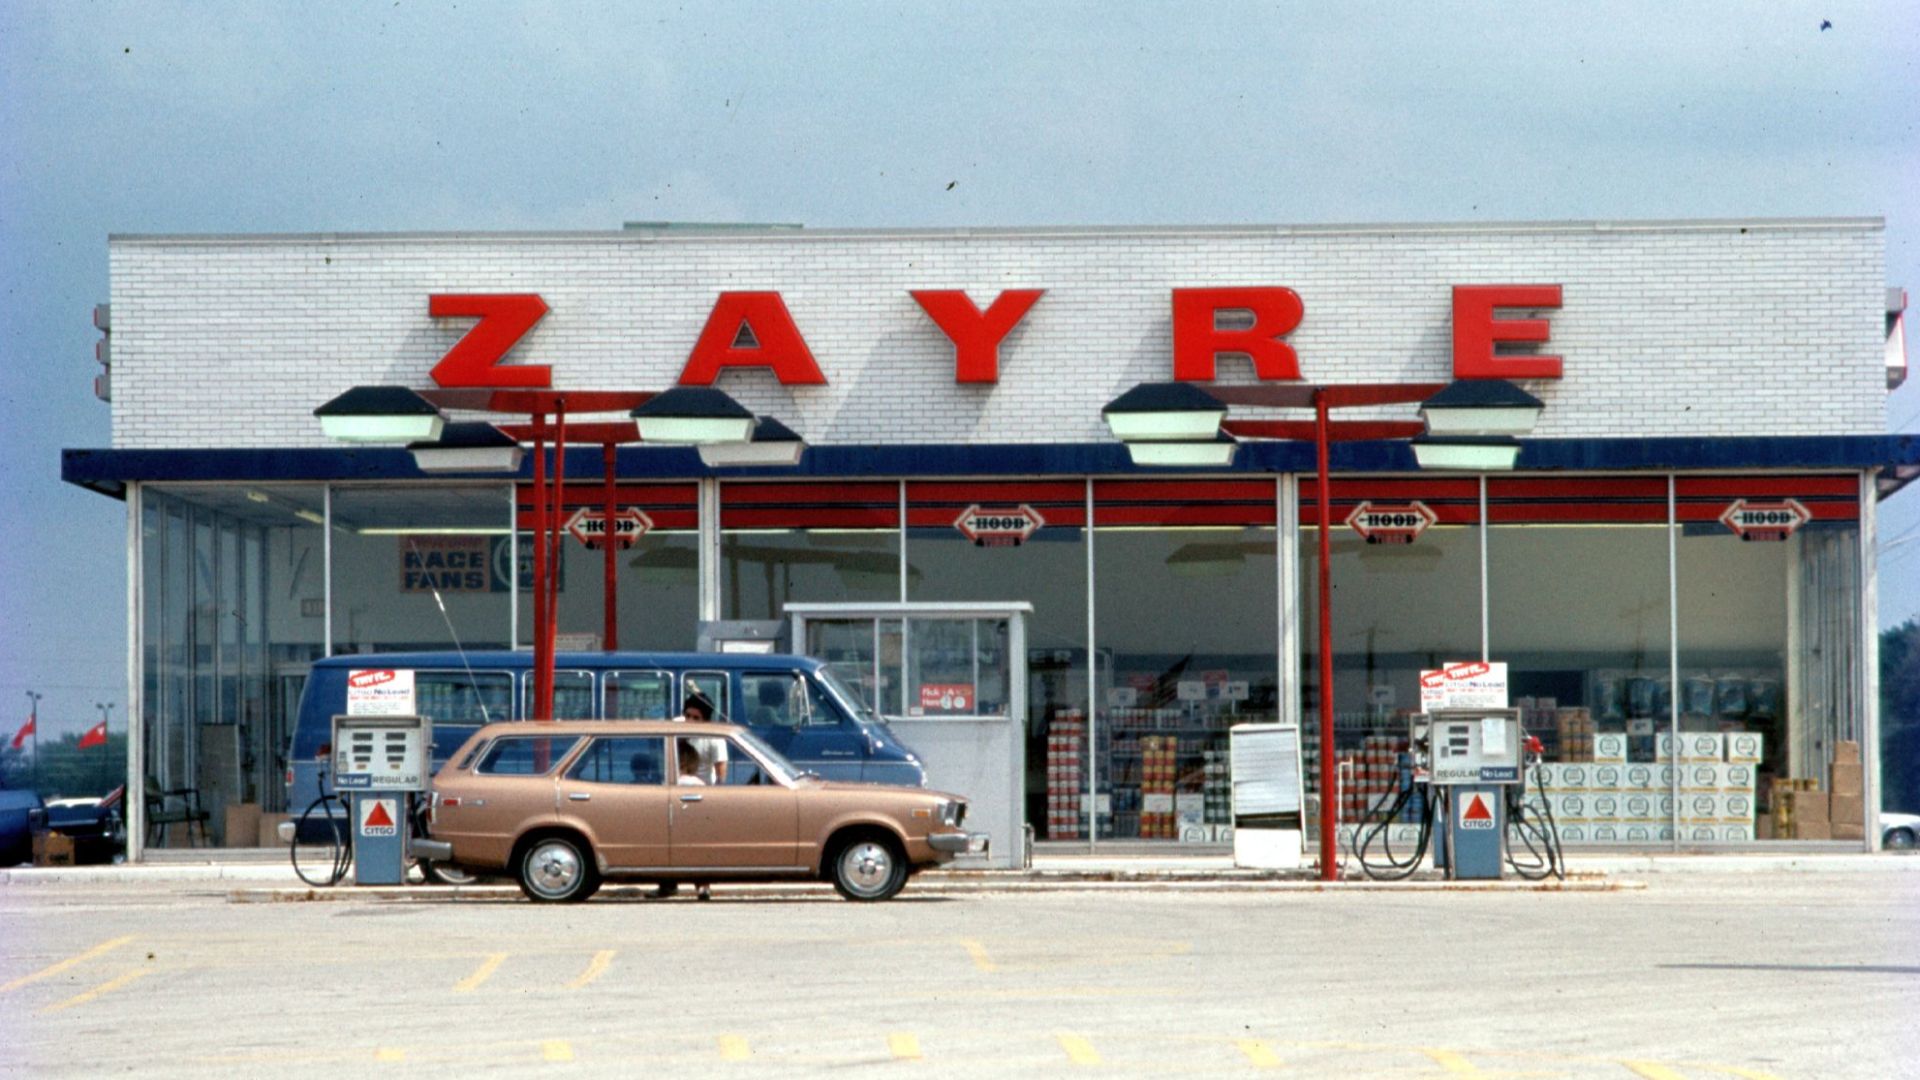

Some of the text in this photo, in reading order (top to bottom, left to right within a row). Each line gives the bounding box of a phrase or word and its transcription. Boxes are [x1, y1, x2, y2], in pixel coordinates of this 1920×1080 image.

[429, 284, 1563, 388] ZAYRE
[976, 517, 1025, 530] HOOD
[1368, 514, 1417, 526] HOOD
[1742, 511, 1791, 524] HOOD
[404, 551, 484, 568] RACE
[405, 571, 484, 589] FANS
[1437, 769, 1480, 778] REGULAR
[349, 776, 368, 785] Lead
[373, 775, 418, 785] REGULAR
[1463, 820, 1492, 828] CITGO
[364, 827, 394, 835] CITGO
